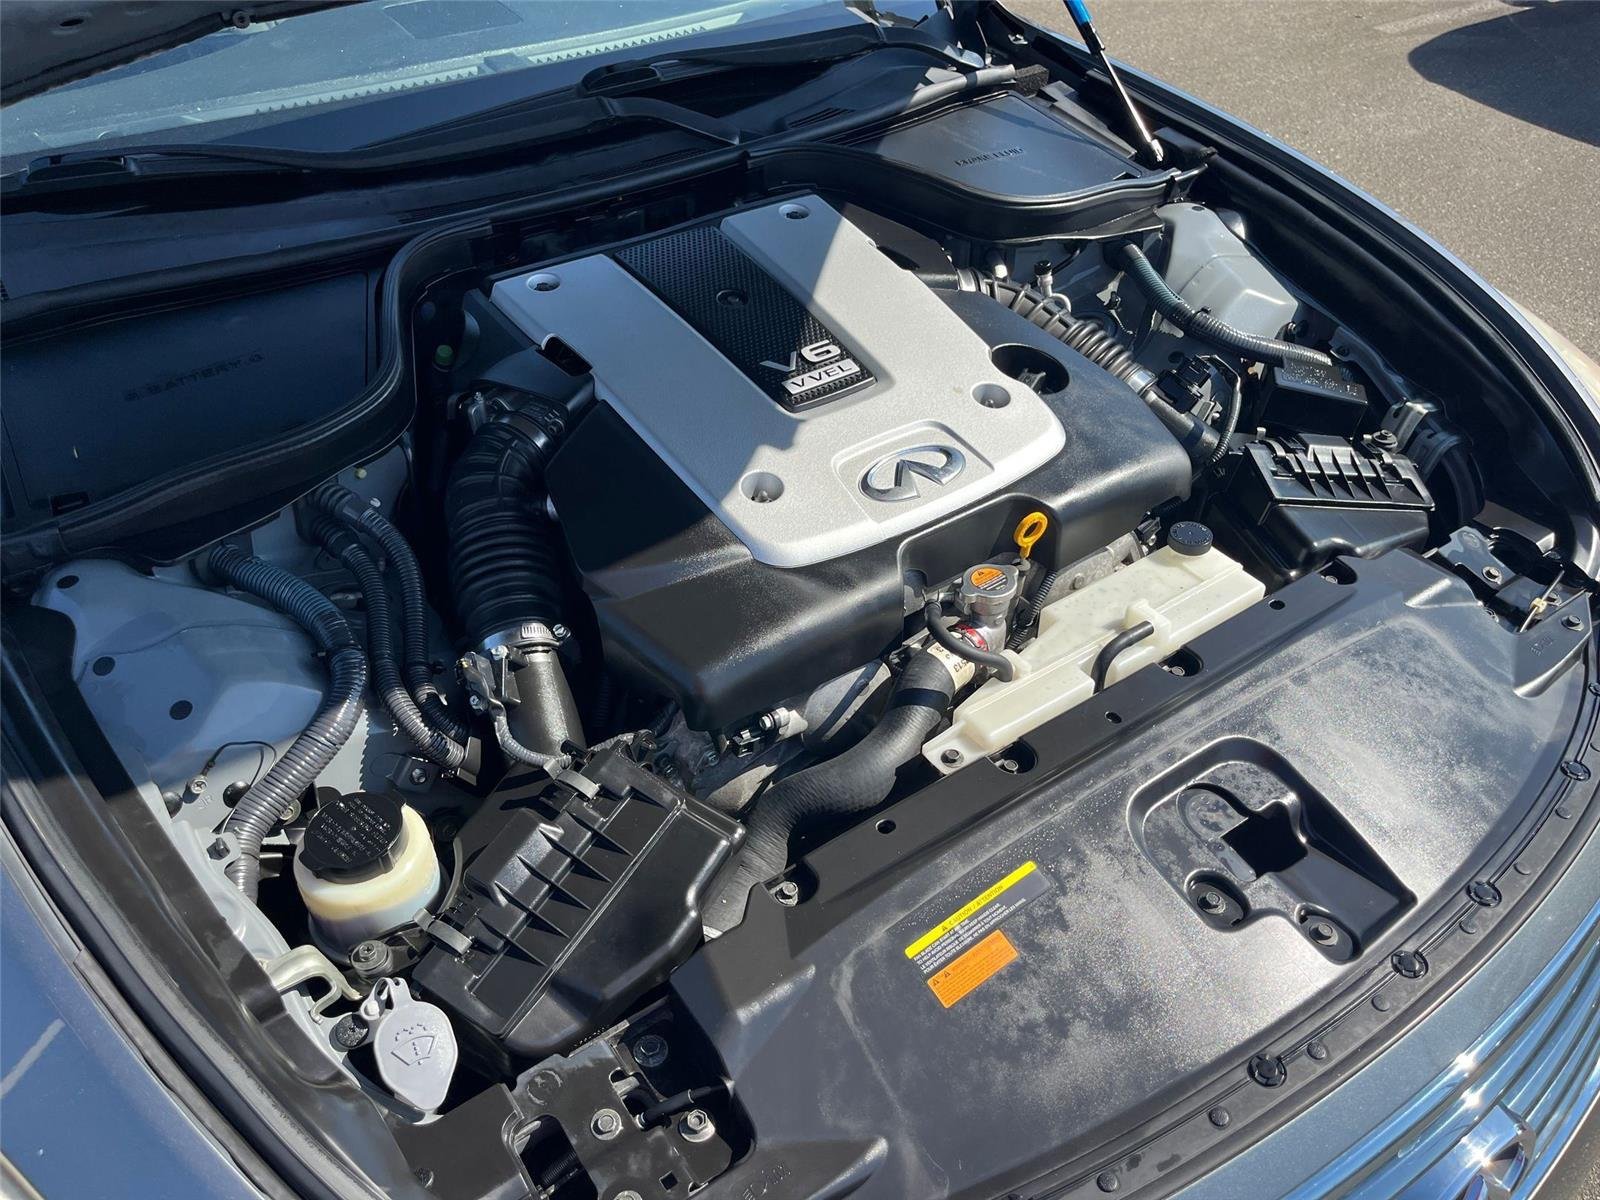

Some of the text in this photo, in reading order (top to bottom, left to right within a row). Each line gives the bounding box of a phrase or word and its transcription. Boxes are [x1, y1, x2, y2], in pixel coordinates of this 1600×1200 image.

[759, 339, 841, 373] V6
[791, 363, 853, 388] VVEL
[975, 884, 1004, 906] ATTENTION
